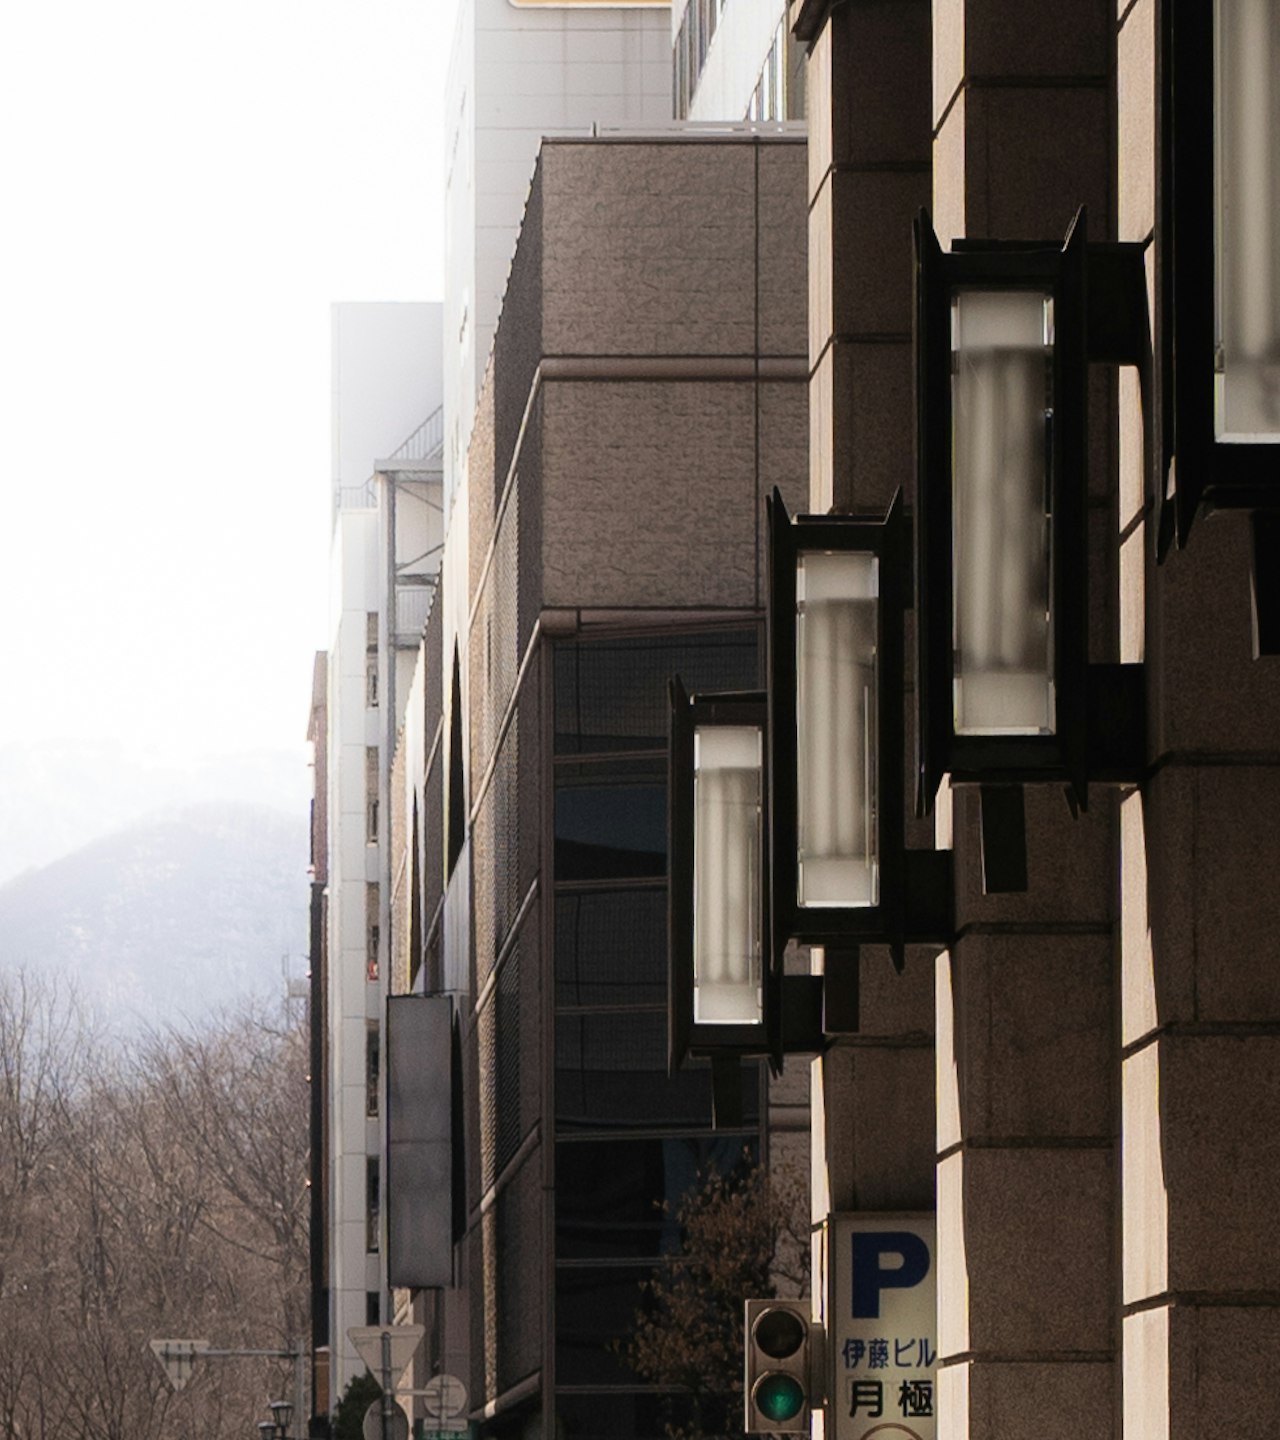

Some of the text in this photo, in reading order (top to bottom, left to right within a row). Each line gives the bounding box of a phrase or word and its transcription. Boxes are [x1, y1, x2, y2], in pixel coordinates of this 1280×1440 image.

[852, 1232, 931, 1319] P
[842, 1337, 937, 1369] 伊藤ビル
[849, 1379, 934, 1418] 月極
